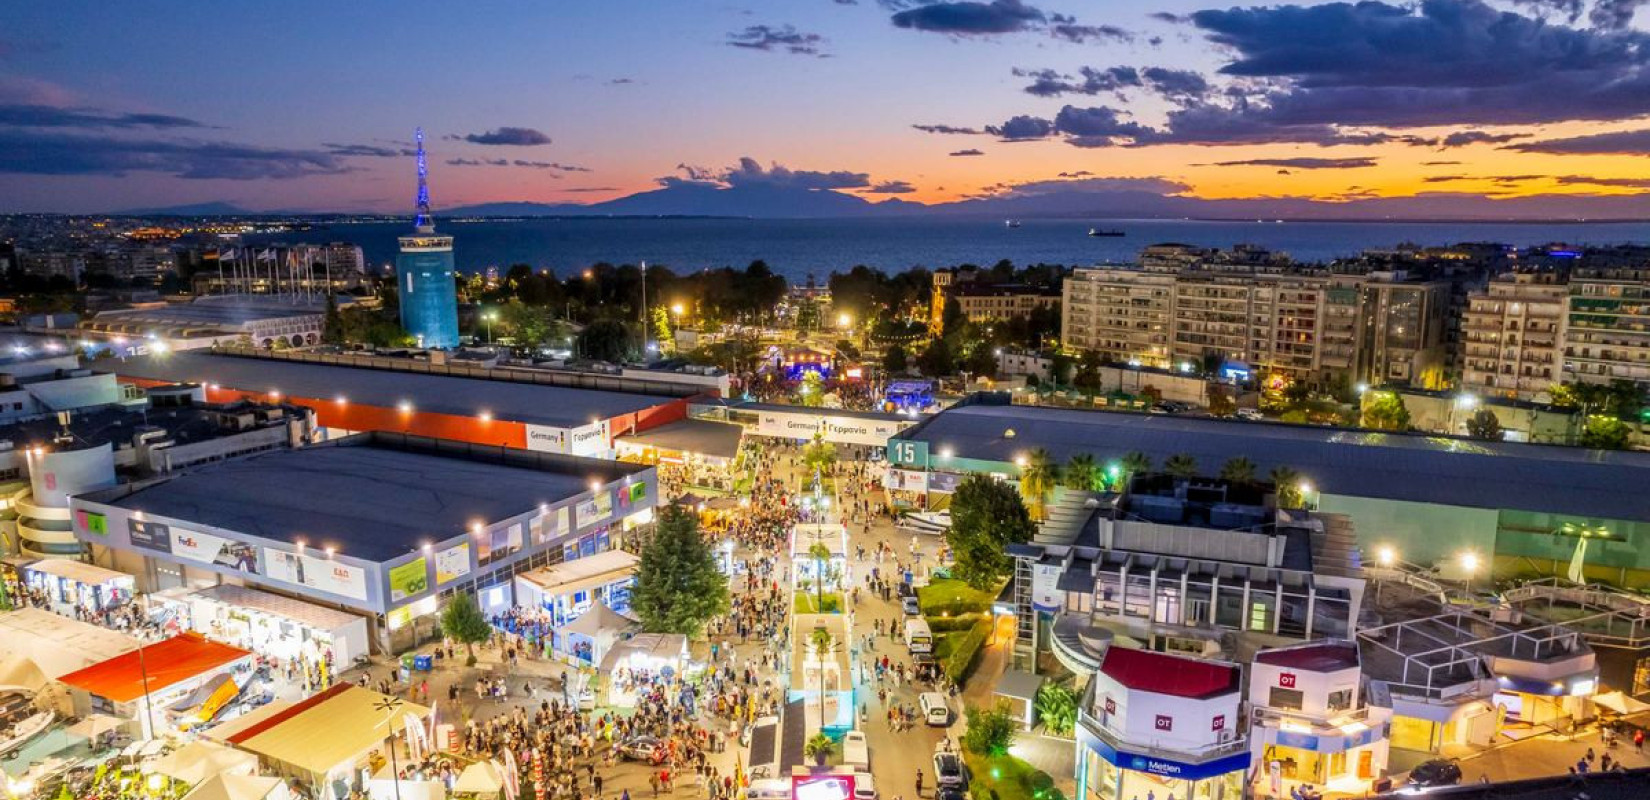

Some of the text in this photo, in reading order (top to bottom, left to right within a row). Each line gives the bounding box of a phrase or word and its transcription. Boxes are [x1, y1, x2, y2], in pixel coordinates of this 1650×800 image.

[787, 420, 820, 433] Germany
[530, 430, 558, 443] Germany
[895, 442, 914, 463] 15
[178, 535, 198, 548] FedEx
[1281, 676, 1295, 685] OT
[1106, 701, 1115, 711] OT
[1157, 719, 1171, 727] OT
[1213, 719, 1224, 728] OT
[1148, 761, 1181, 774] Metlen
